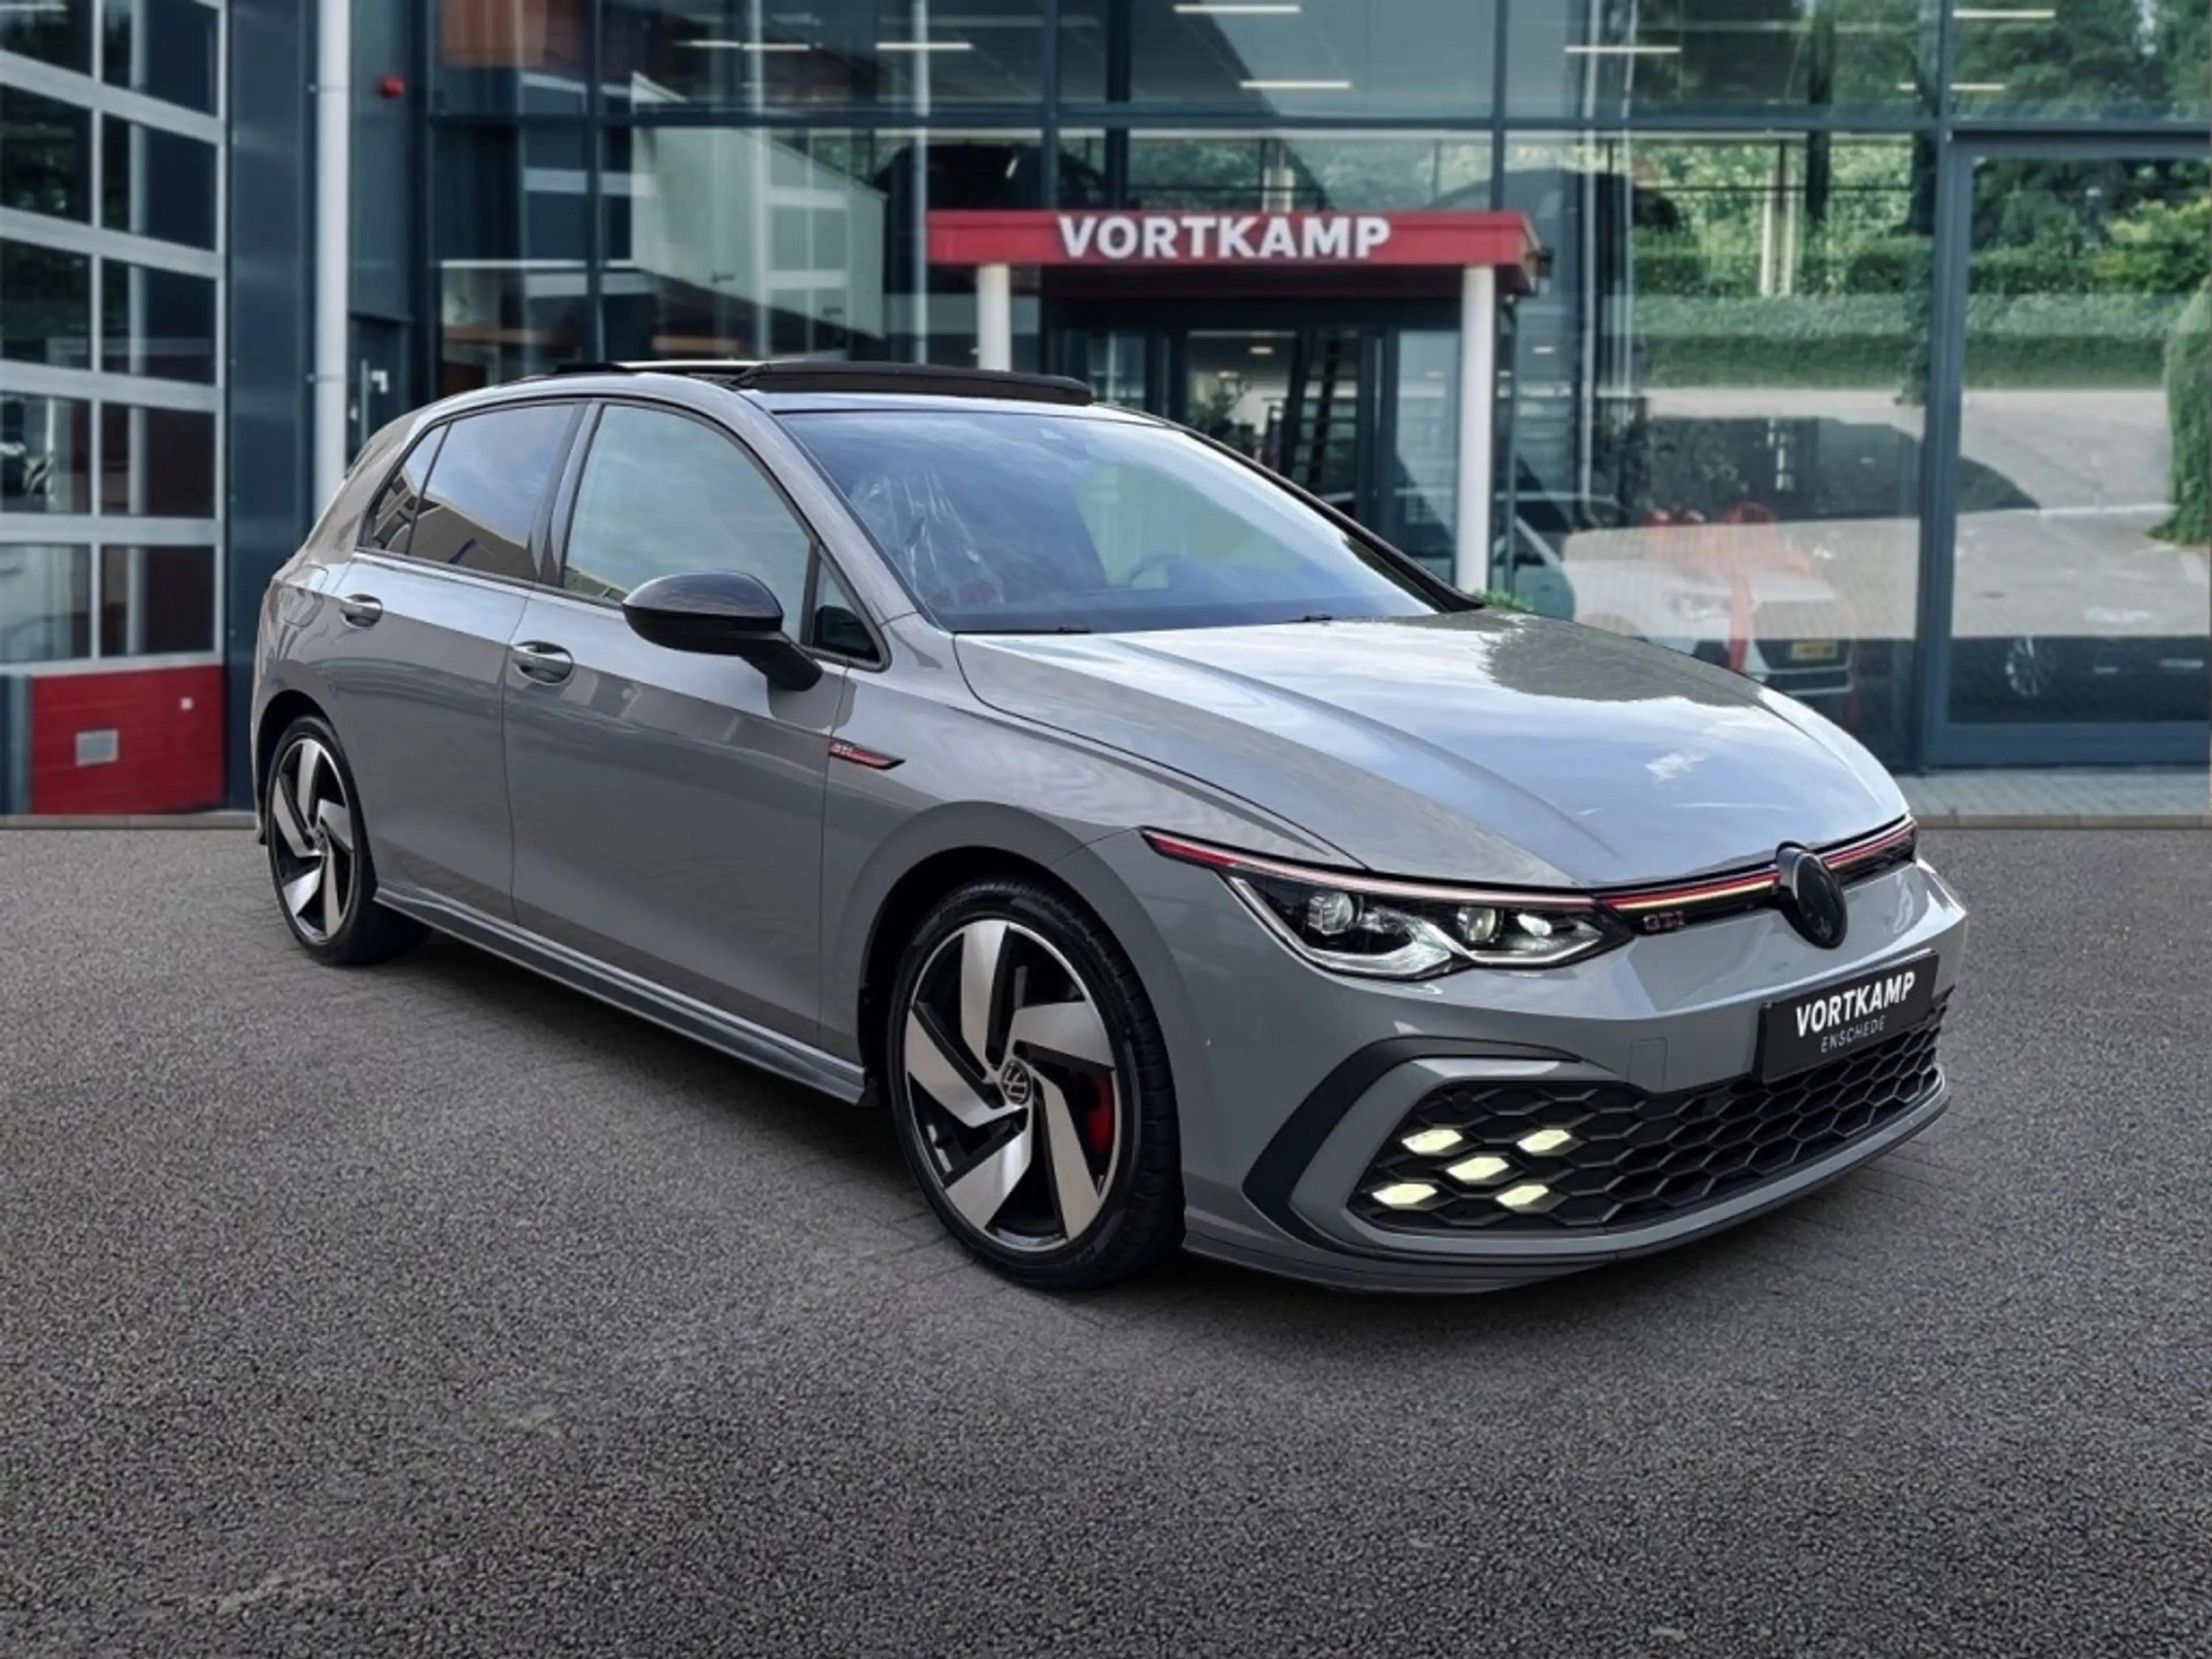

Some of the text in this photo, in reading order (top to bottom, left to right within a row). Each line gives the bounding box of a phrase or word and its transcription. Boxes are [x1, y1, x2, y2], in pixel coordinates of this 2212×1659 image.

[1058, 215, 1390, 259] VORTKAMP
[1796, 971, 1915, 1038] VORTKAMP
[1820, 1014, 1886, 1054] ENSCHEDE
